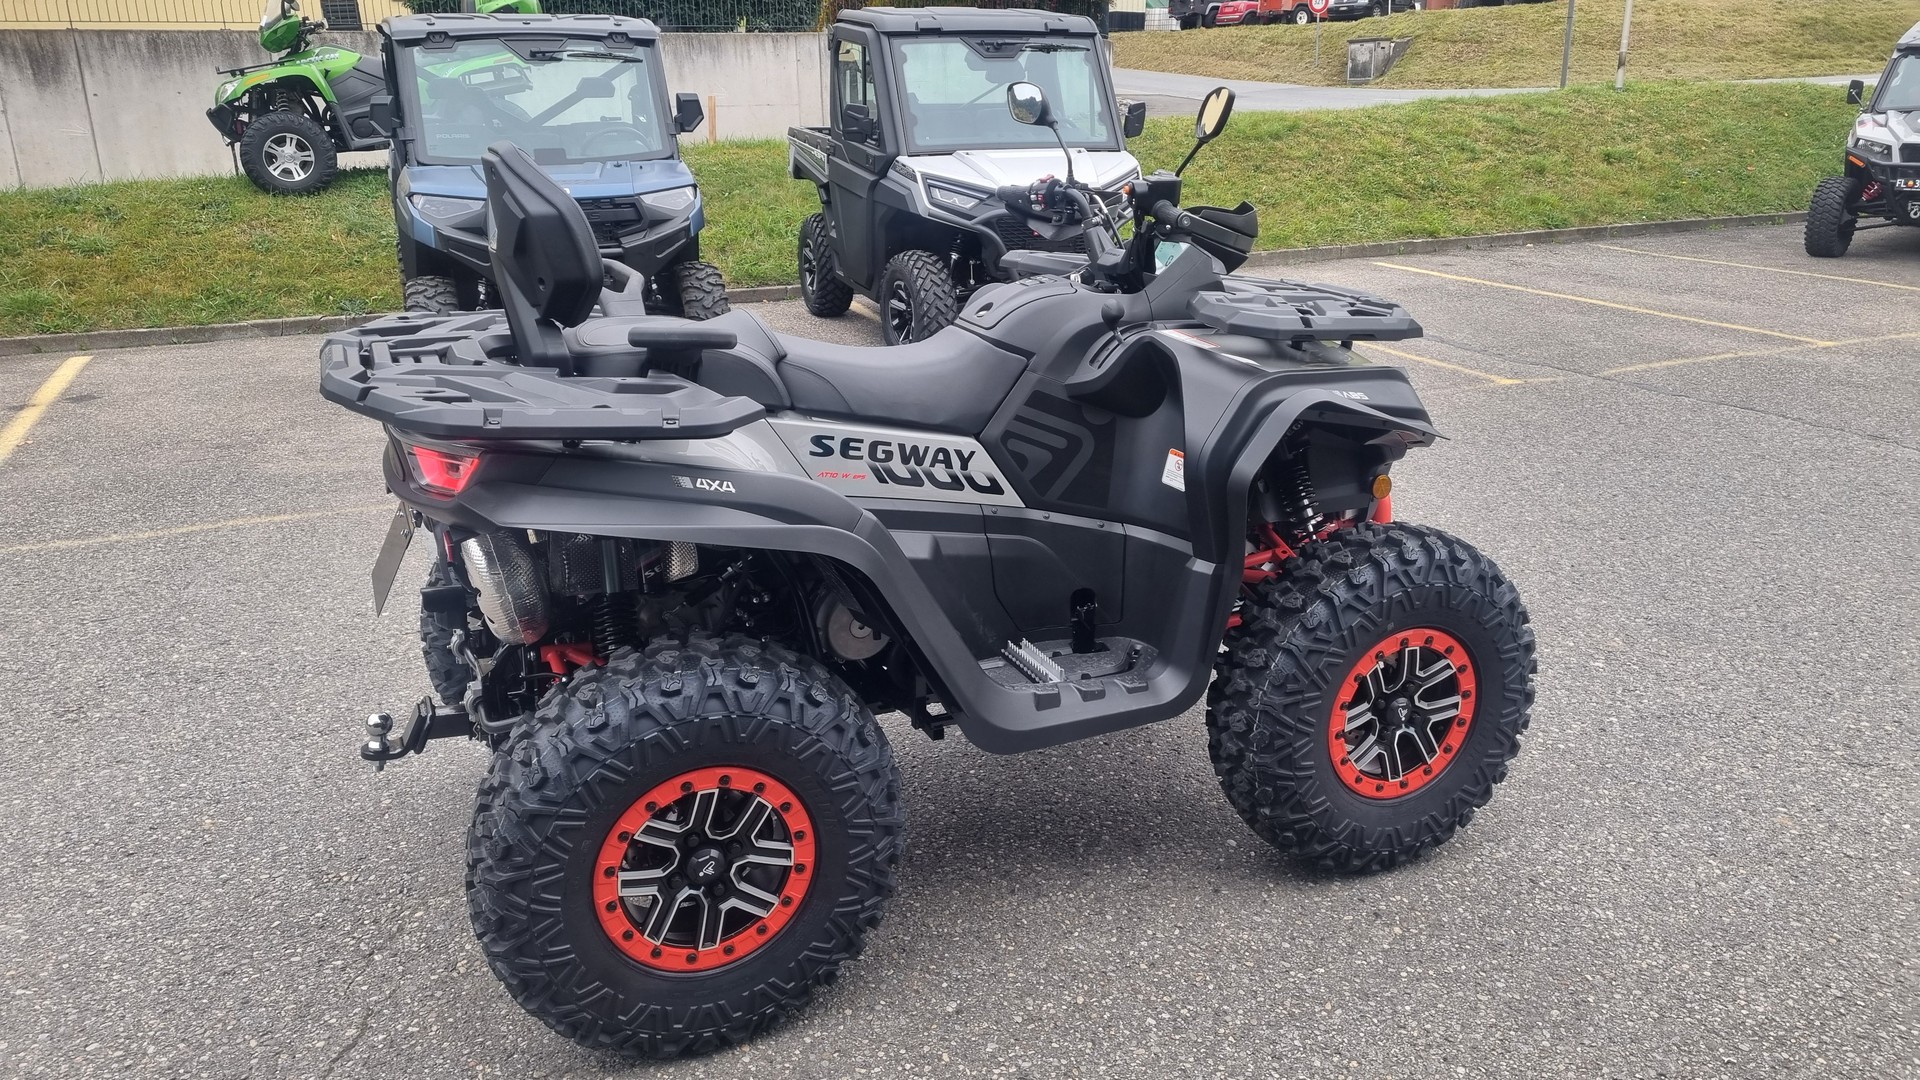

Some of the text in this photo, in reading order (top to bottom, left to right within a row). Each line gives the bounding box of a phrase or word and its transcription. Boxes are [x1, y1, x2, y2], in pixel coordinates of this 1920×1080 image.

[1895, 178, 1906, 188] FL
[809, 435, 976, 471] SEGWAY
[696, 478, 736, 494] 4X4
